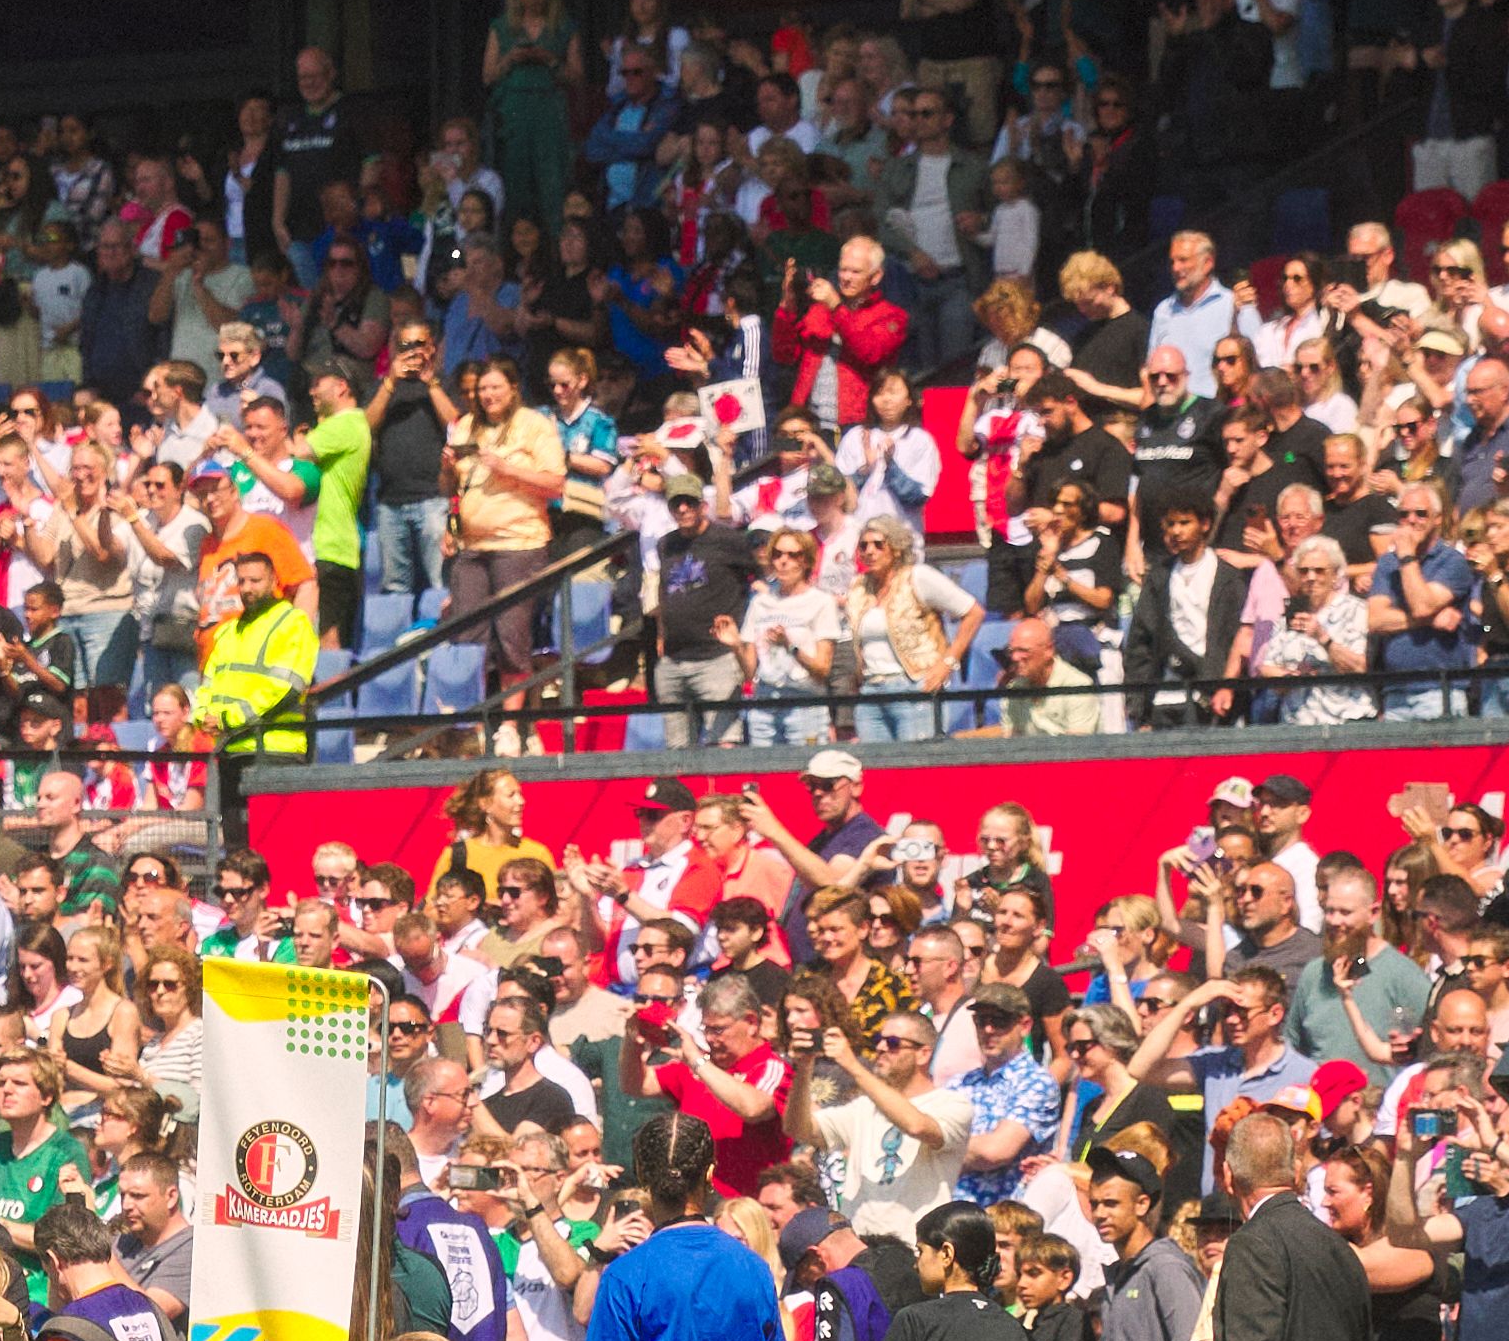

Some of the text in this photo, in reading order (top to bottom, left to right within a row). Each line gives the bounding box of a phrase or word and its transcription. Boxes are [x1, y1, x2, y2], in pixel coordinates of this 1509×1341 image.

[240, 1122, 313, 1156] FEYENOORD
[239, 1173, 312, 1207] ROTTERDAM
[227, 1191, 326, 1230] KAMERAADJES
